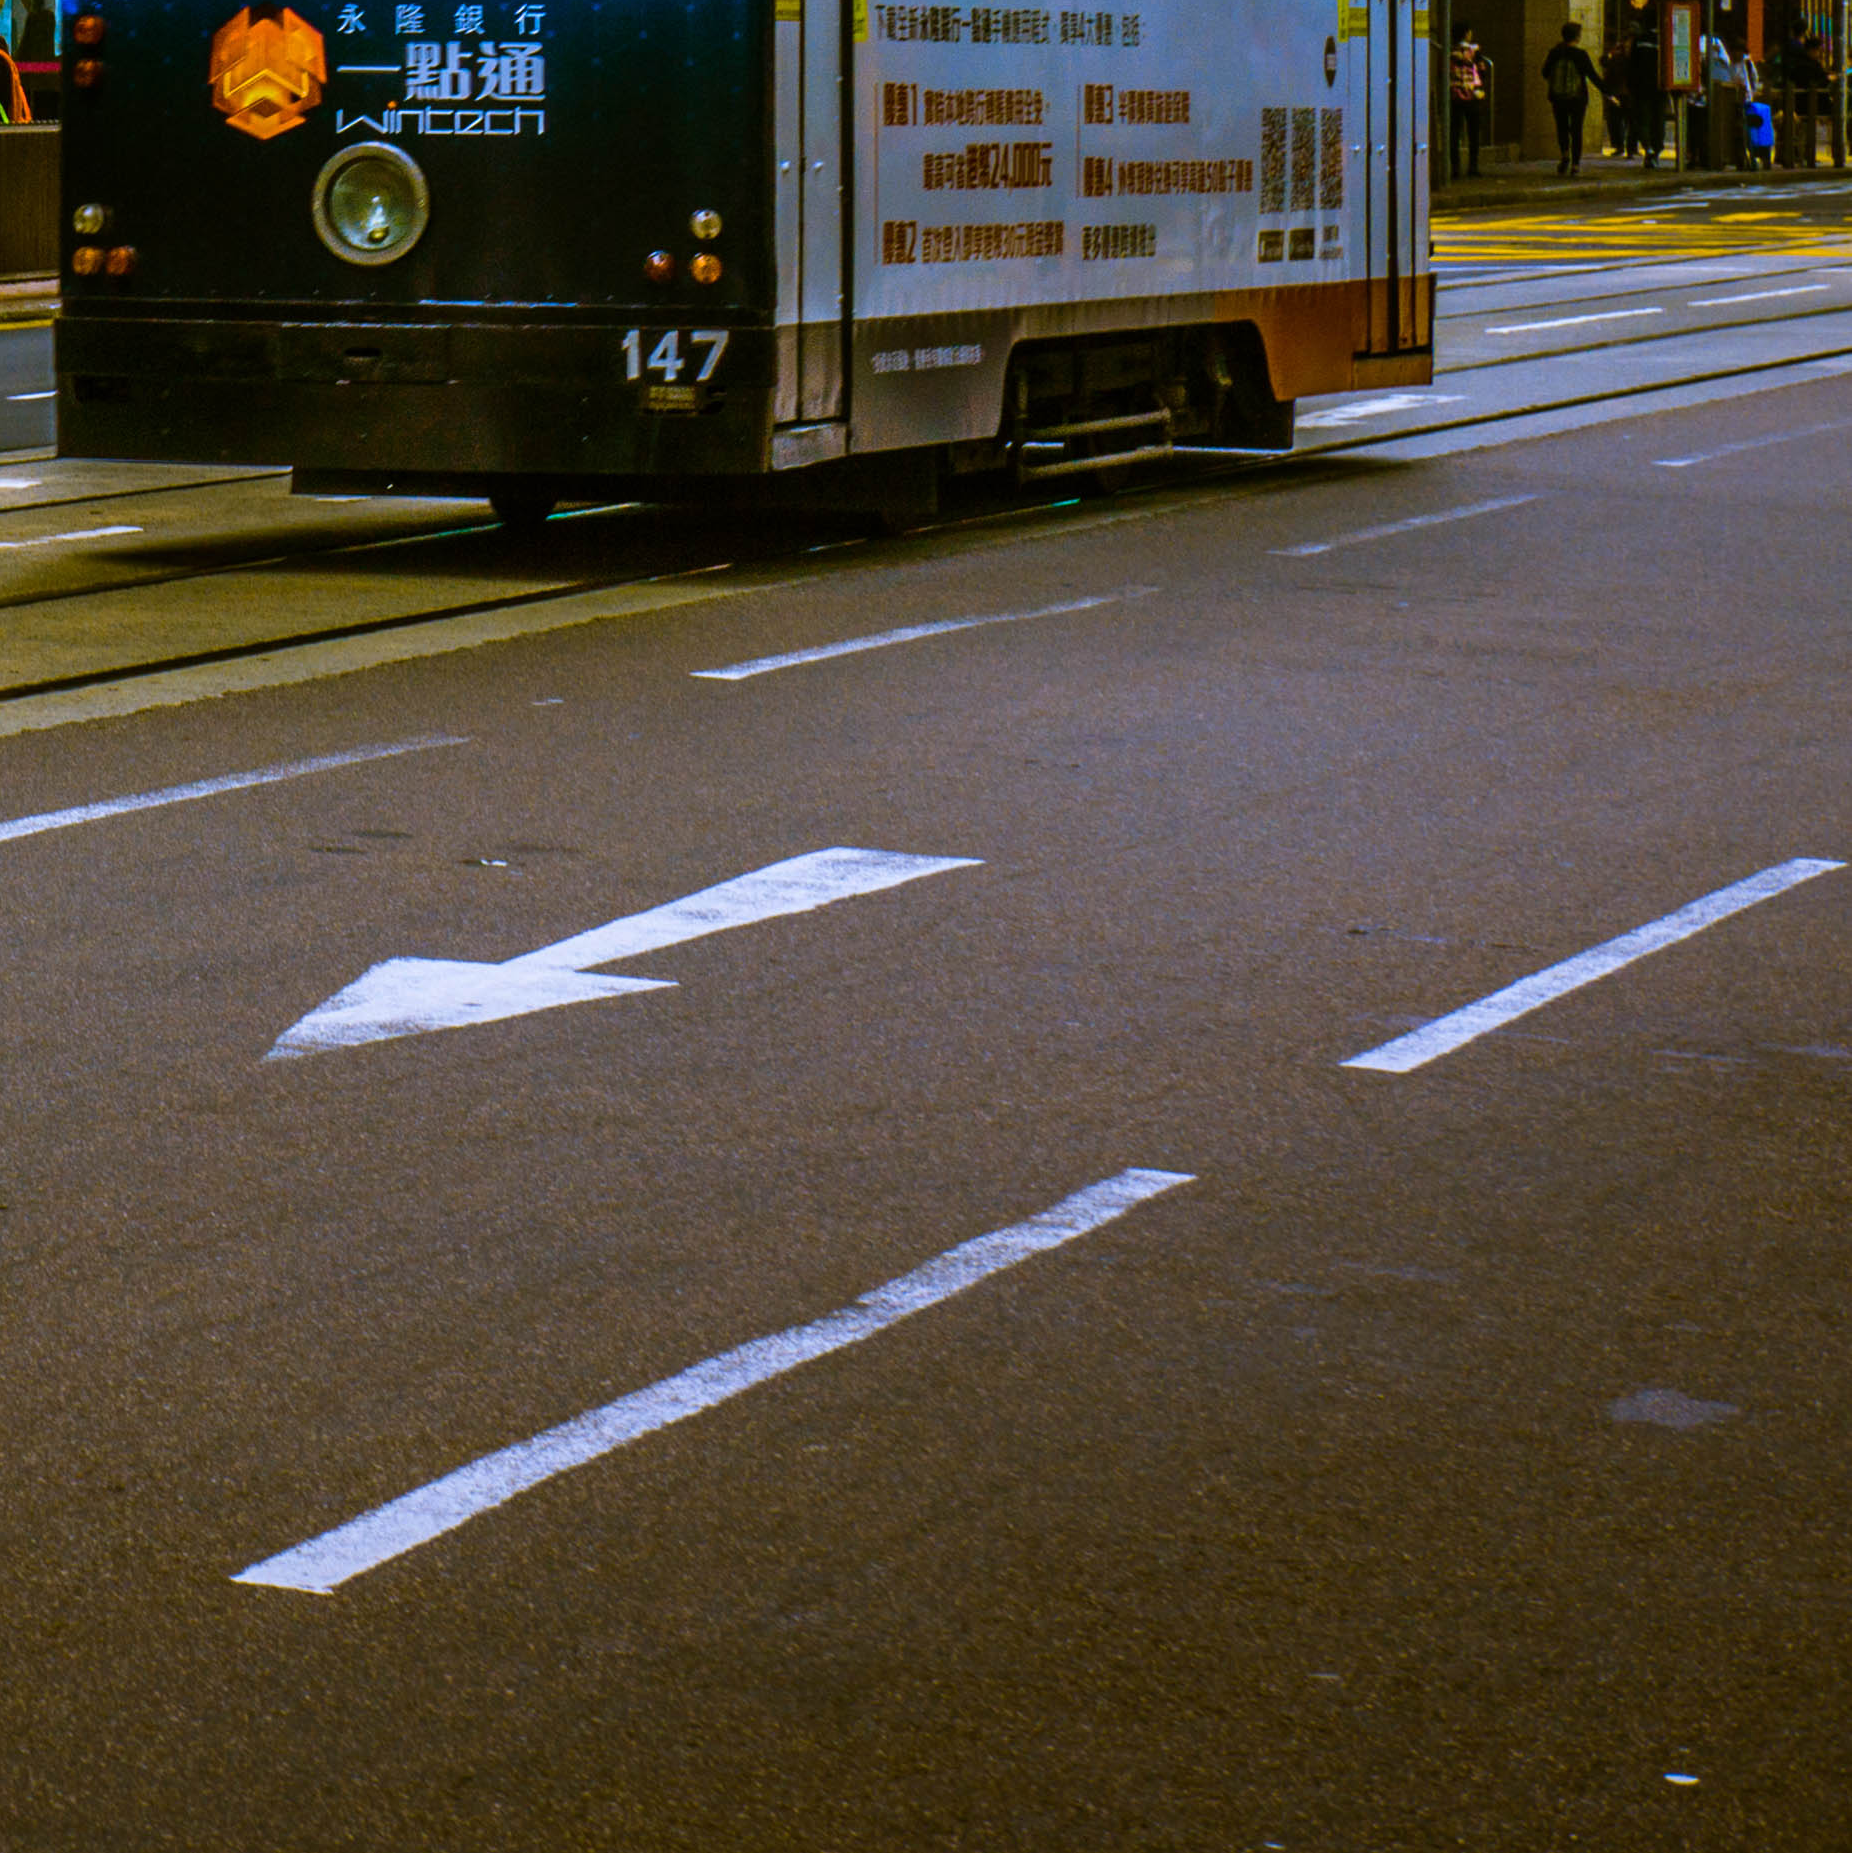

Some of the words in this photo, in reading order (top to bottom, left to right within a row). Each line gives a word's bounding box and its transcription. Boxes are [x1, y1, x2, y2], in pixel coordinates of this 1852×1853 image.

[336, 2, 548, 37] 永隆銀行
[336, 41, 548, 104] 一點通
[620, 328, 731, 383] 147
